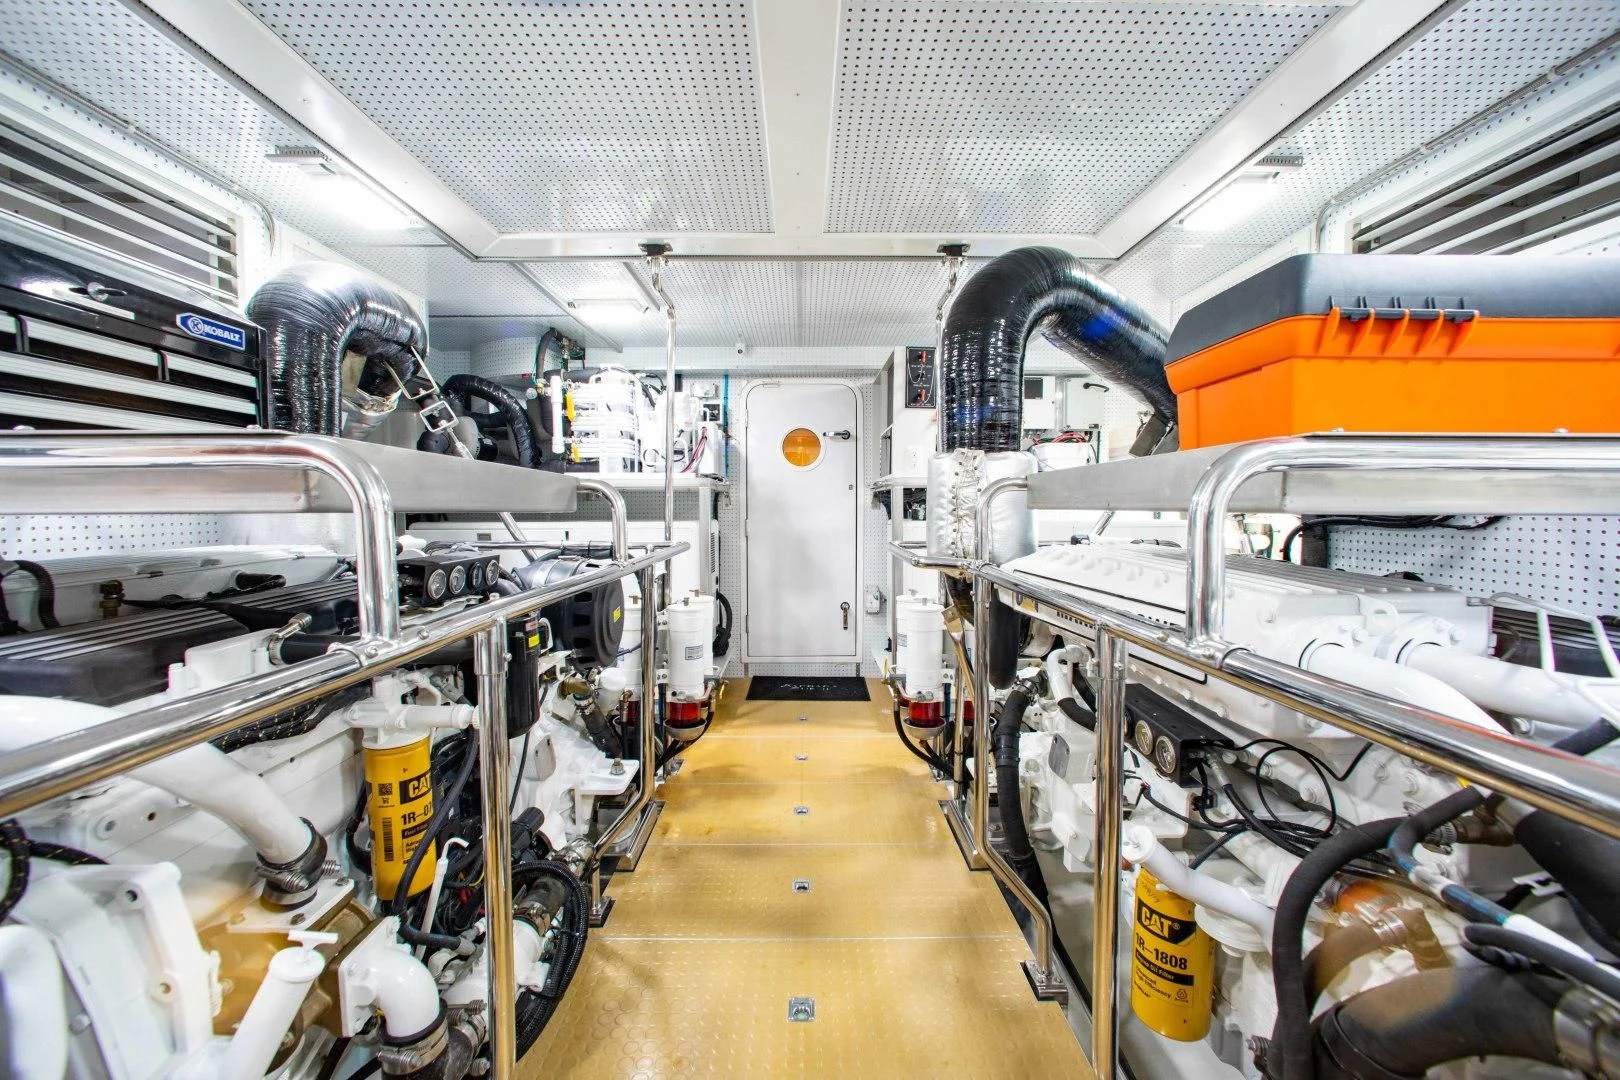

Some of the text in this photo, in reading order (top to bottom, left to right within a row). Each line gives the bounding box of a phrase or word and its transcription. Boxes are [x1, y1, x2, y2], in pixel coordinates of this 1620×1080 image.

[204, 324, 241, 342] KOBALT
[409, 773, 431, 798] CAT
[1142, 906, 1170, 939] CAT
[1136, 932, 1188, 970] 1R-1808
